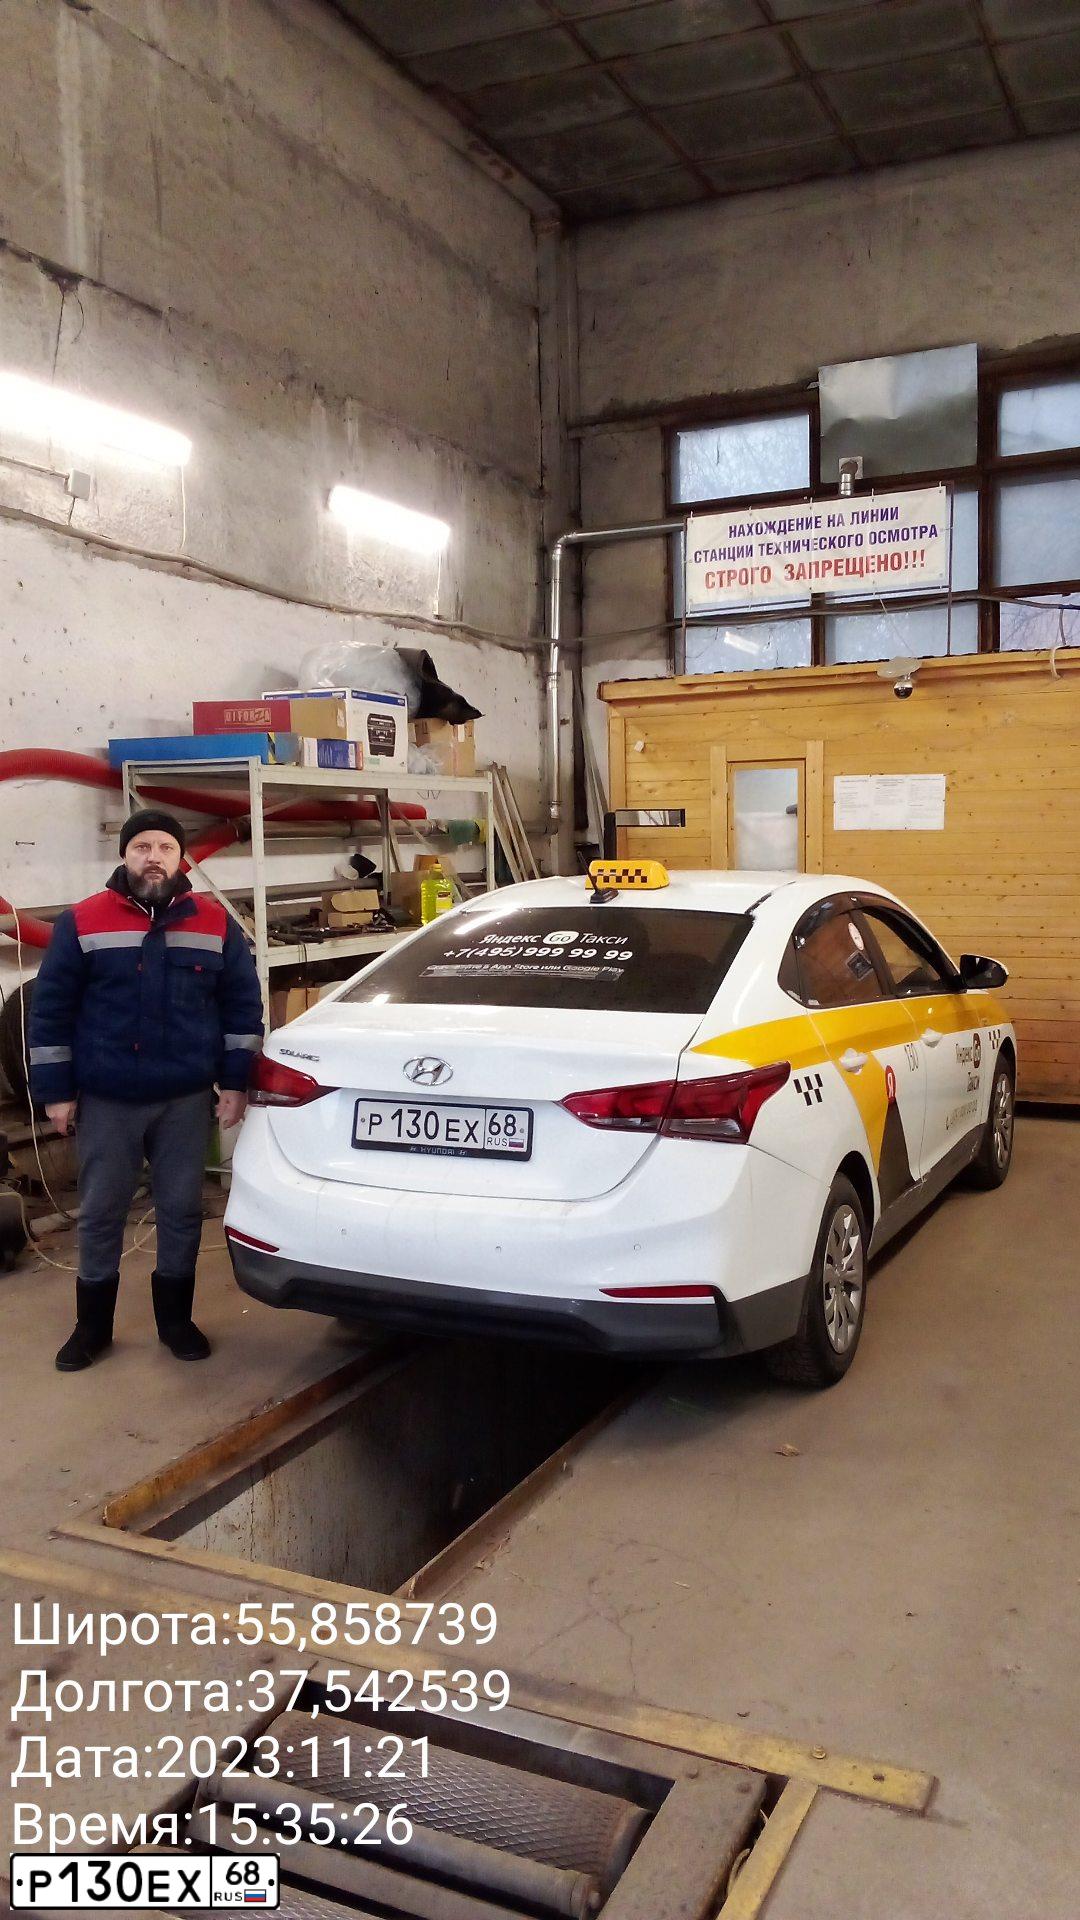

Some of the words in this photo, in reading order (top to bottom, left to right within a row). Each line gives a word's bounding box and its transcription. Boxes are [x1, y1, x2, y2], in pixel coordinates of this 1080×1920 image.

[728, 515, 822, 539] НАХОЖДЕНИЕ
[827, 513, 846, 528] НА
[849, 506, 899, 526] ЛИНИИ
[694, 544, 754, 564] СТАНЦИИ
[758, 532, 864, 558] ТЕХНИЧЕСКОГО
[868, 524, 938, 546] ОСМОТРА
[704, 565, 772, 590] СТРОГО
[784, 549, 926, 582] ЗАПРЕЩЕНО!!!
[478, 933, 541, 944] Яндекс
[549, 933, 571, 942] Go
[579, 933, 629, 945] Такси
[567, 948, 597, 959] 99
[603, 950, 633, 961] 99
[488, 1112, 518, 1138] 68
[420, 1146, 455, 1155] HYUNDAI
[487, 1136, 508, 1147] RUS
